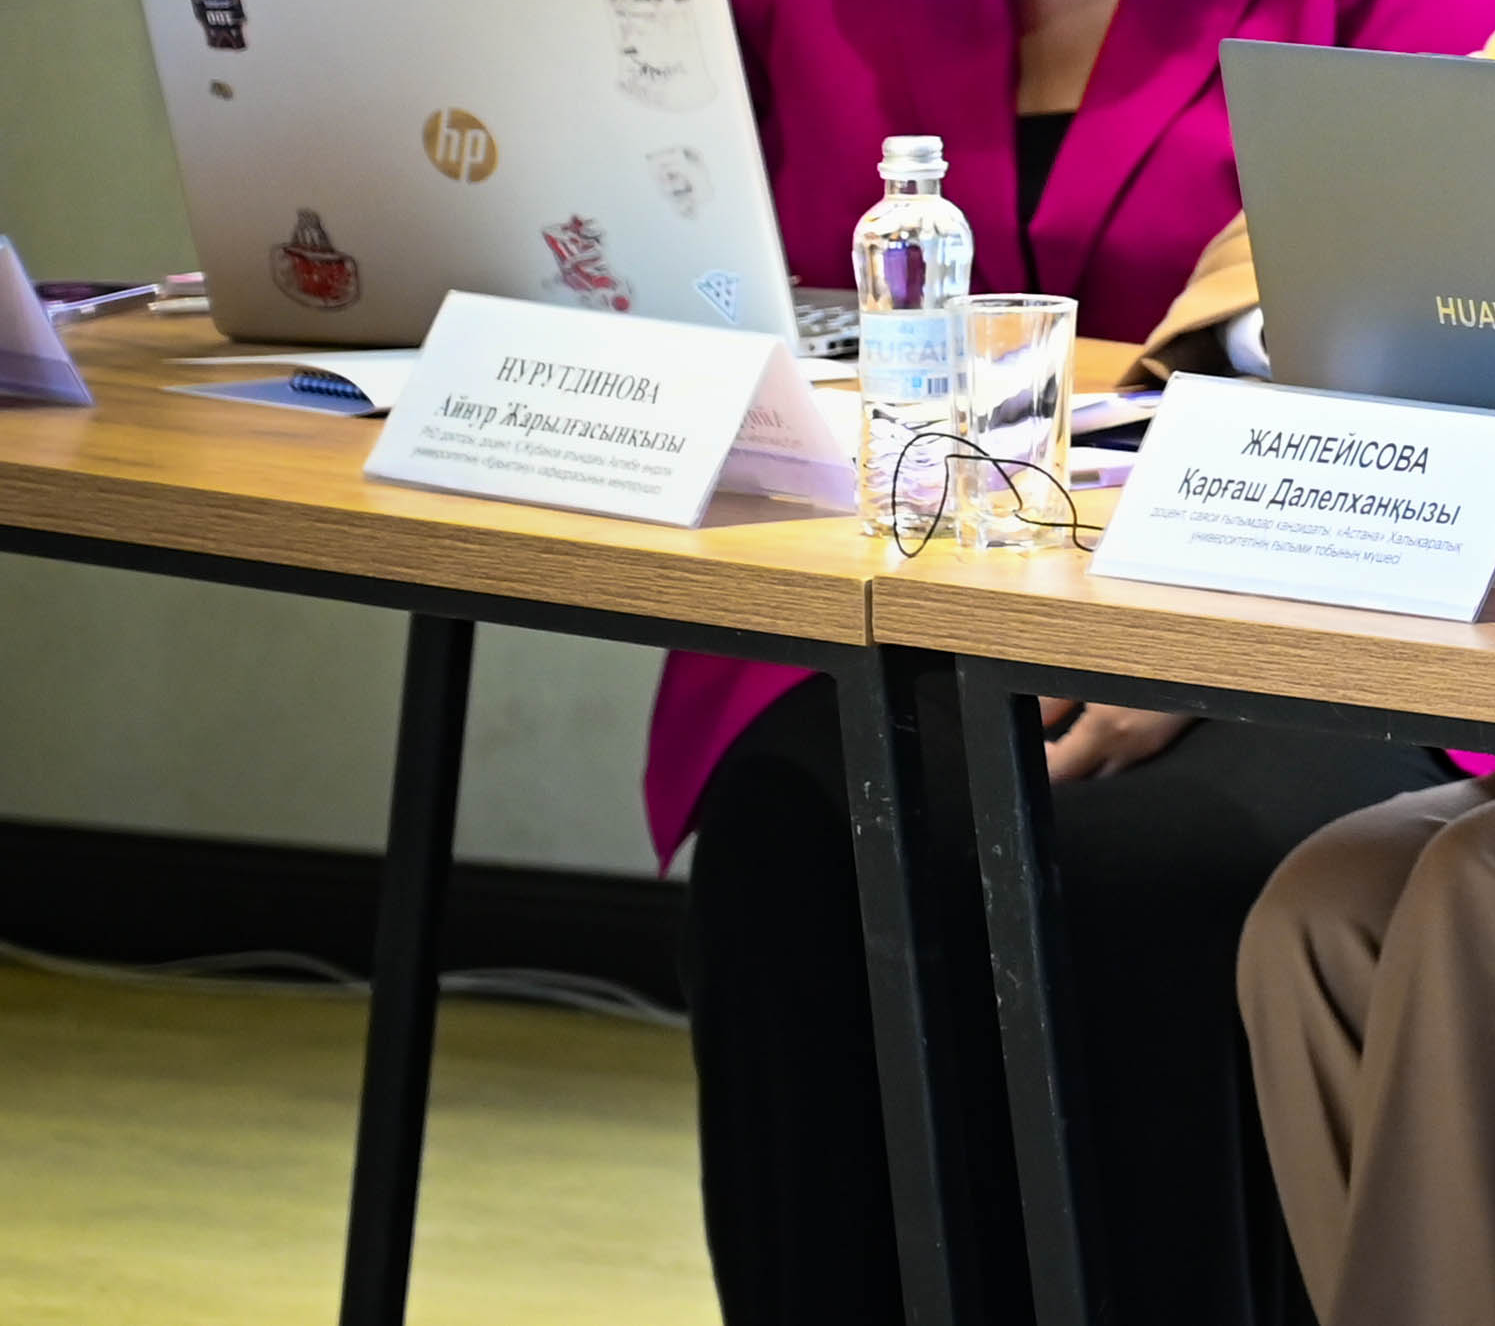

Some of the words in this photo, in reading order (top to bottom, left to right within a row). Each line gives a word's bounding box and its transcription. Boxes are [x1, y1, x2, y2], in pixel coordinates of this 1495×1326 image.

[434, 108, 488, 182] hp
[1241, 428, 1429, 474] ЖАНПЕЙІСОВА
[1177, 467, 1268, 504] Қарғаш
[1265, 478, 1461, 526] Далелханқызы
